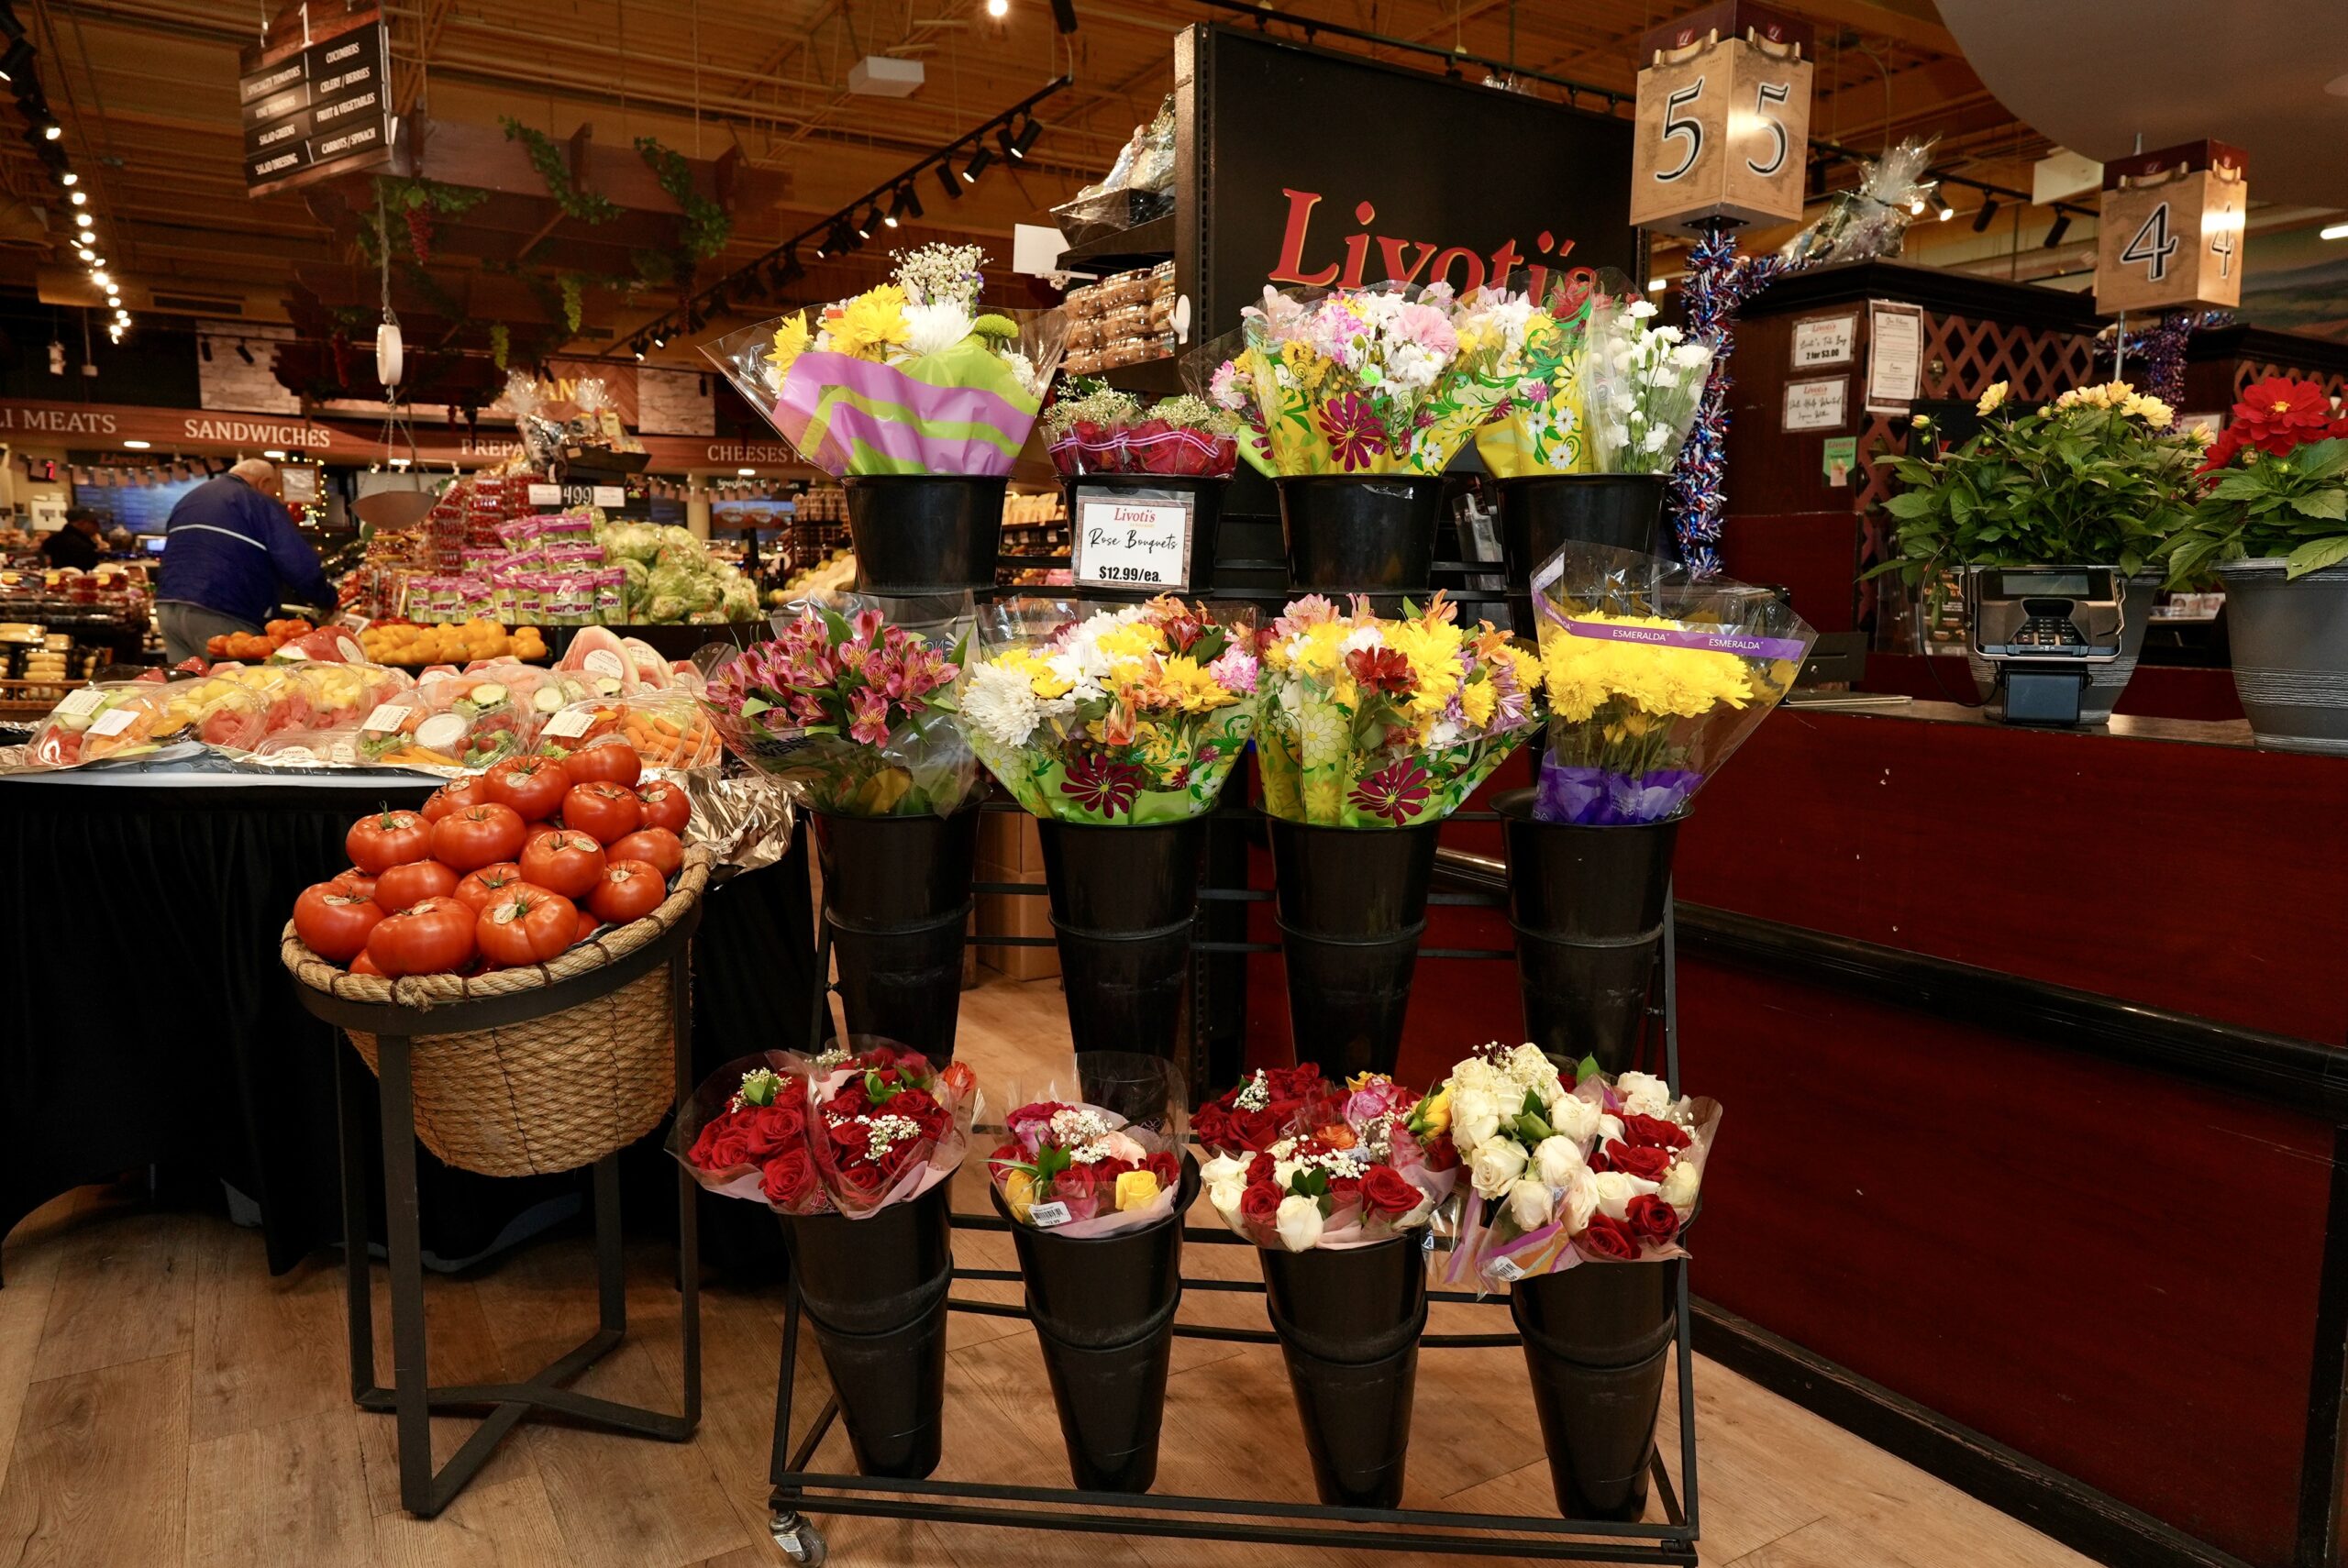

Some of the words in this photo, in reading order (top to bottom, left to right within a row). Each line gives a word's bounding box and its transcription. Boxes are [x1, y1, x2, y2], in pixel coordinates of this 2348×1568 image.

[298, 2, 314, 48] 1
[1655, 75, 1705, 182] 5
[1746, 82, 1789, 176] 5
[2121, 202, 2178, 282] 4
[2211, 202, 2234, 279] 4
[22, 409, 116, 434] MEATS
[184, 419, 330, 447] SANDWICHES
[461, 438, 526, 457] PREPA
[707, 445, 788, 463] CHEESES
[1113, 507, 1156, 523] Livoti's
[1089, 528, 1121, 548] Rose
[1124, 529, 1178, 554] Bouquets
[1099, 566, 1162, 582] $12.99/ea.
